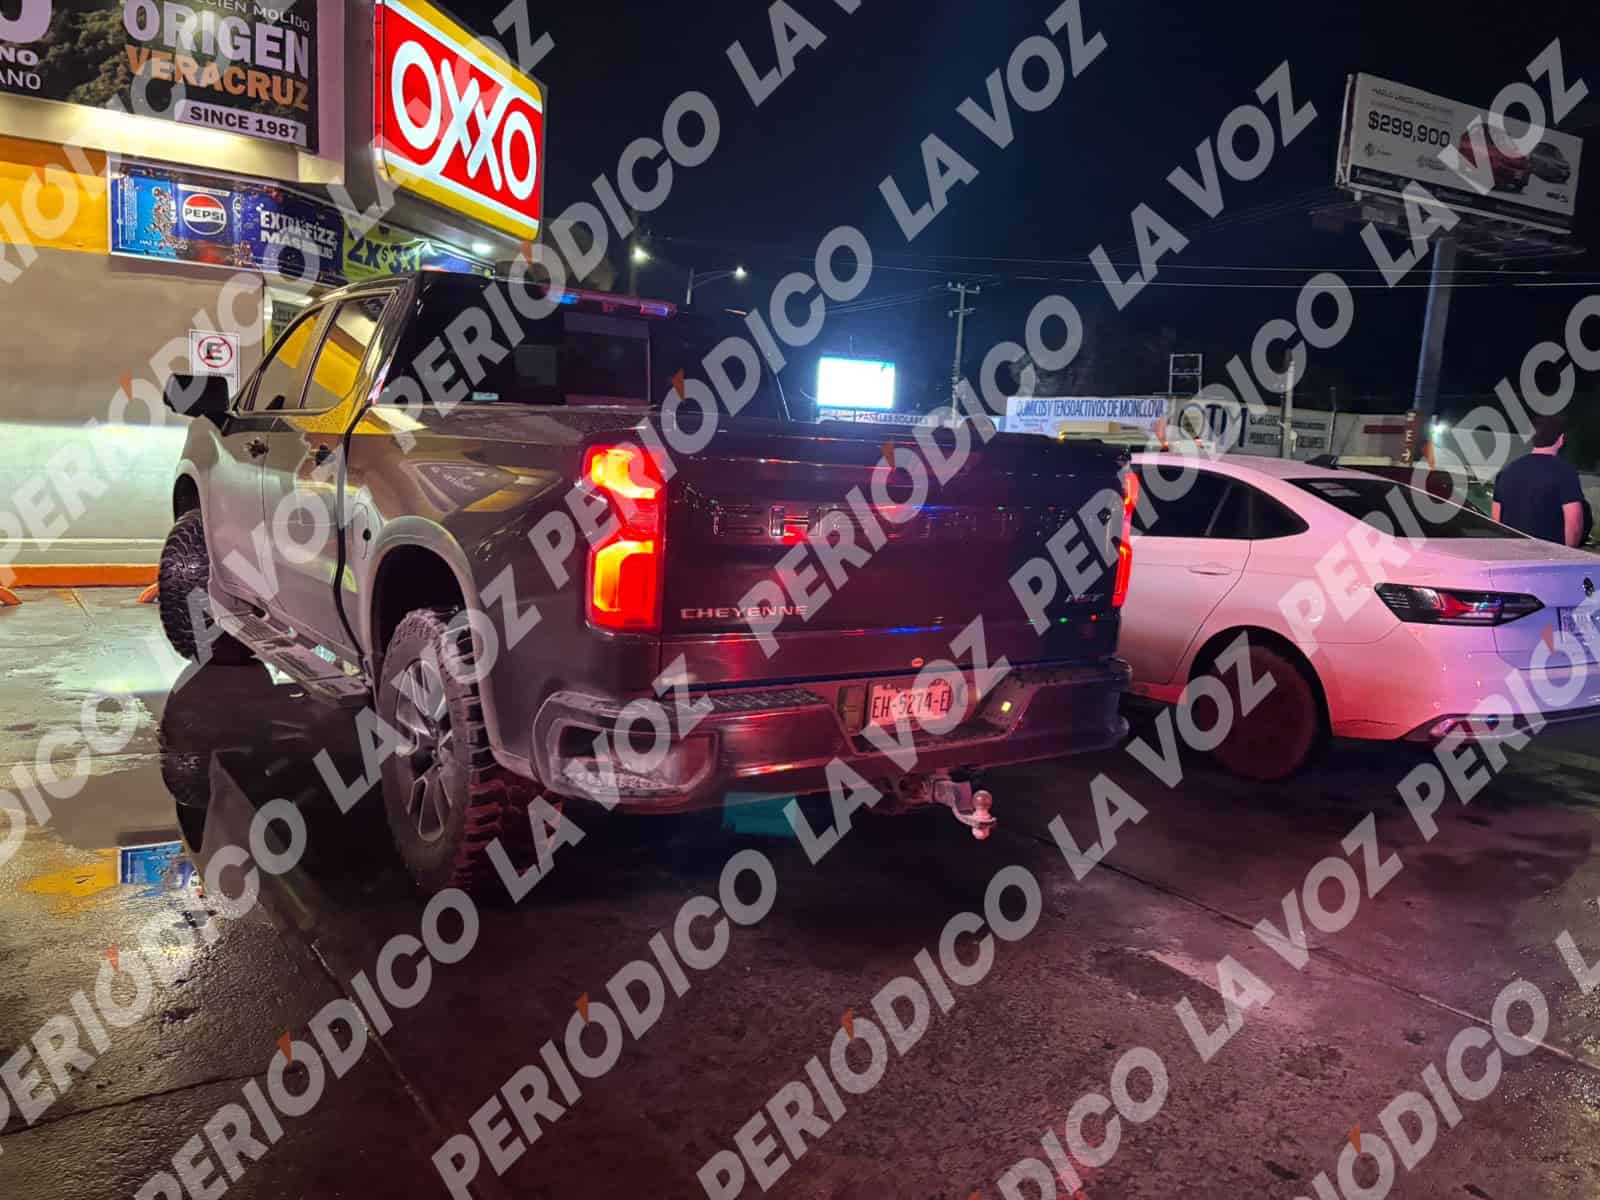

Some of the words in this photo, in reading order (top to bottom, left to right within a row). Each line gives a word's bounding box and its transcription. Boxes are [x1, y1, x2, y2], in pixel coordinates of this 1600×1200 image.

[206, 0, 246, 12] CIEN
[253, 7, 310, 32] MOLIDO
[123, 0, 309, 79] ORIGEN
[125, 44, 309, 112] VERACRUZ
[190, 106, 249, 130] SINCE
[255, 119, 299, 140] 1987
[391, 40, 537, 200] OXXO
[1367, 110, 1450, 148] $299,900
[184, 208, 224, 222] PEPSI
[681, 605, 808, 619] CHEYENNE
